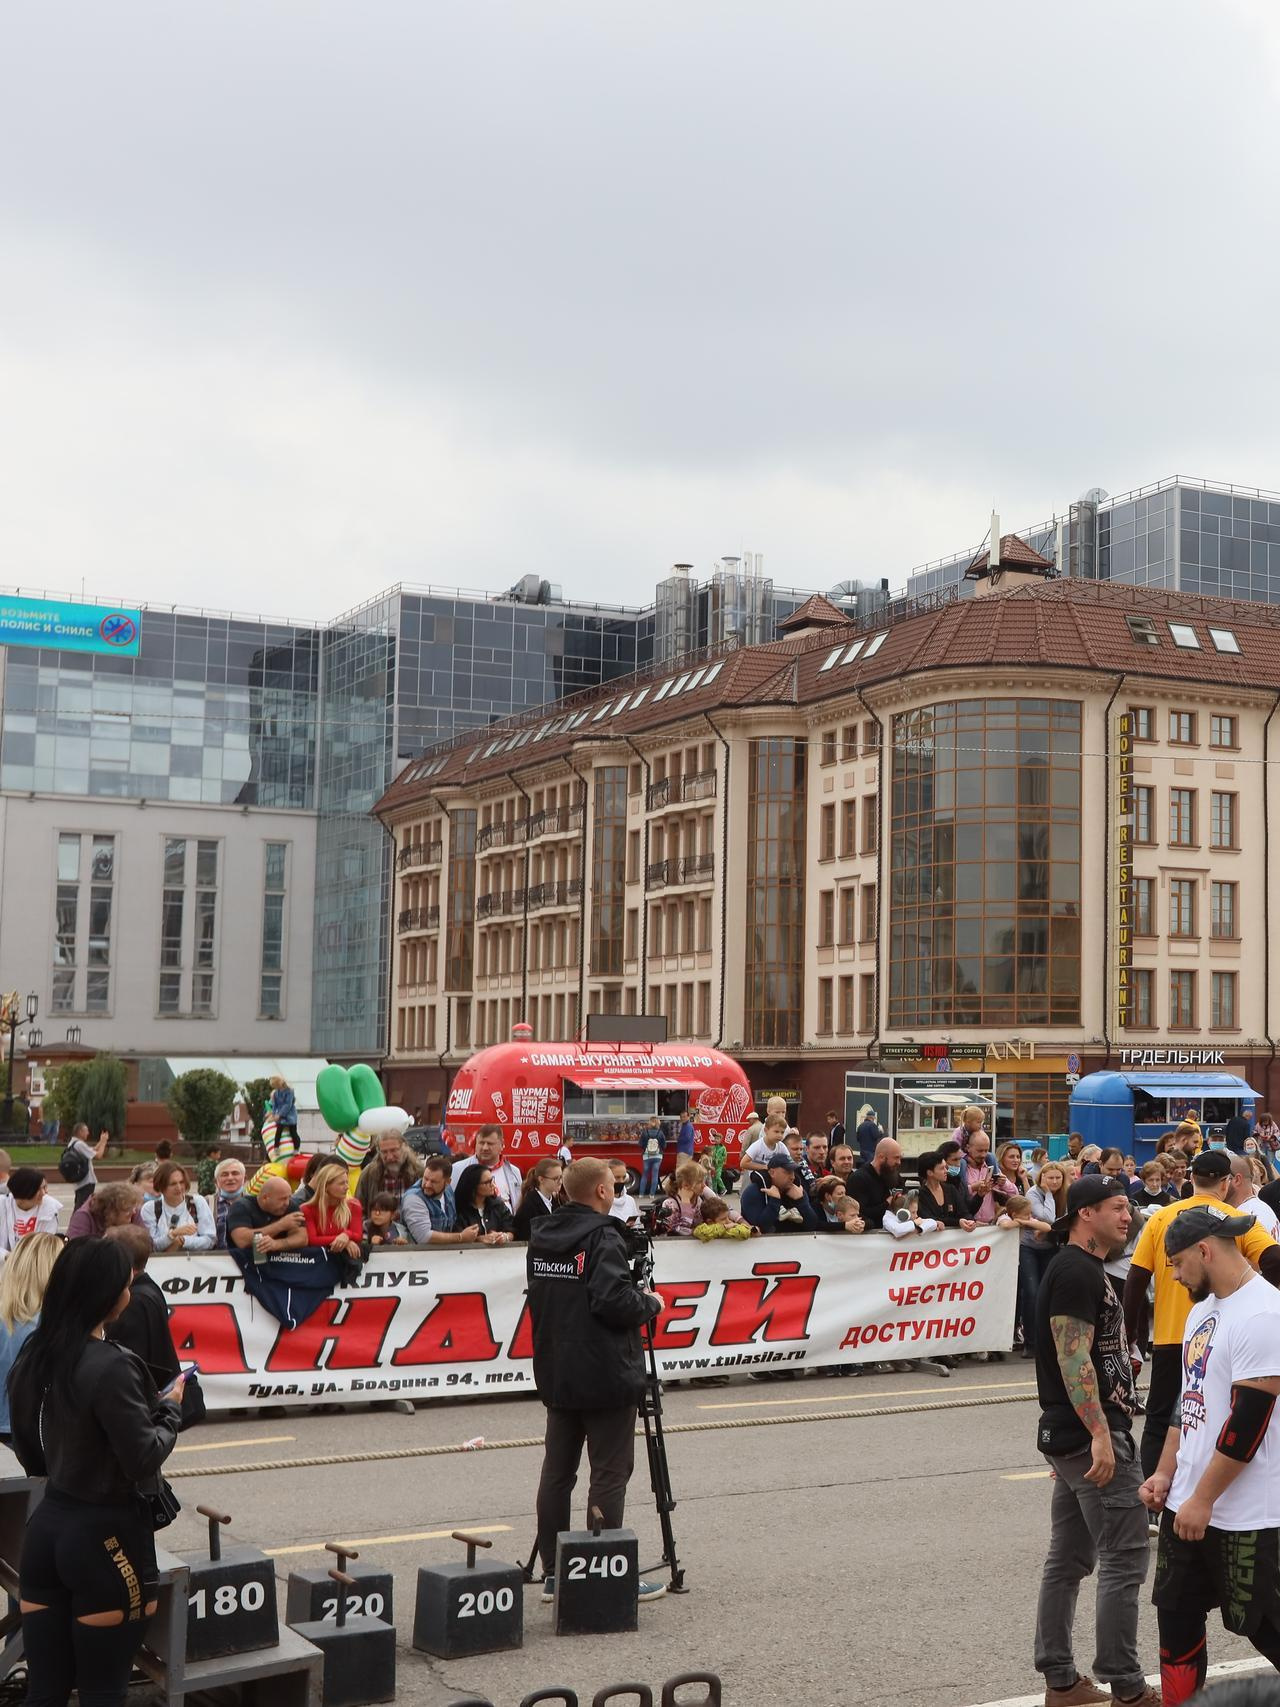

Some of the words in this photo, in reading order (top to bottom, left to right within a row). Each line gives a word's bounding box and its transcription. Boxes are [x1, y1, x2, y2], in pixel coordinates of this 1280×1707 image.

[0, 607, 61, 622] ВОЗЬМИТЕ
[0, 618, 41, 632] ПОЛИС
[43, 622, 52, 633] И
[54, 625, 93, 637] СНИЛС
[1120, 713, 1129, 812] HOTEL
[1119, 826, 1128, 1026] RESTAURANT
[531, 1053, 713, 1068] САМАЯ-ВКУСНАЯ-ШАУРМА.РФ
[1119, 1050, 1225, 1066] ТРДЕЛЬНИК
[449, 1088, 473, 1109] СВШ
[512, 1087, 549, 1097] ШАУРМА
[521, 1100, 537, 1108] ФРИ
[521, 1107, 537, 1117] КОФЕ
[533, 1261, 574, 1274] ТУЛЬСКИЙ
[889, 1245, 991, 1272] ПРОСТО
[162, 1276, 246, 1294] ФИТ
[888, 1281, 984, 1307] ЧЕСТНО
[839, 1316, 976, 1350] ДОСТУПНО
[661, 1349, 807, 1371] www.tulasila.ru
[248, 1383, 304, 1399] Тула,
[311, 1382, 344, 1396] ул.
[350, 1377, 439, 1391] Болдина
[446, 1373, 479, 1387] 94,
[112, 1548, 141, 1609] NEBBIA
[567, 1554, 629, 1580] 240
[188, 1581, 265, 1620] 180
[322, 1592, 385, 1622] 220
[457, 1587, 514, 1618] 200
